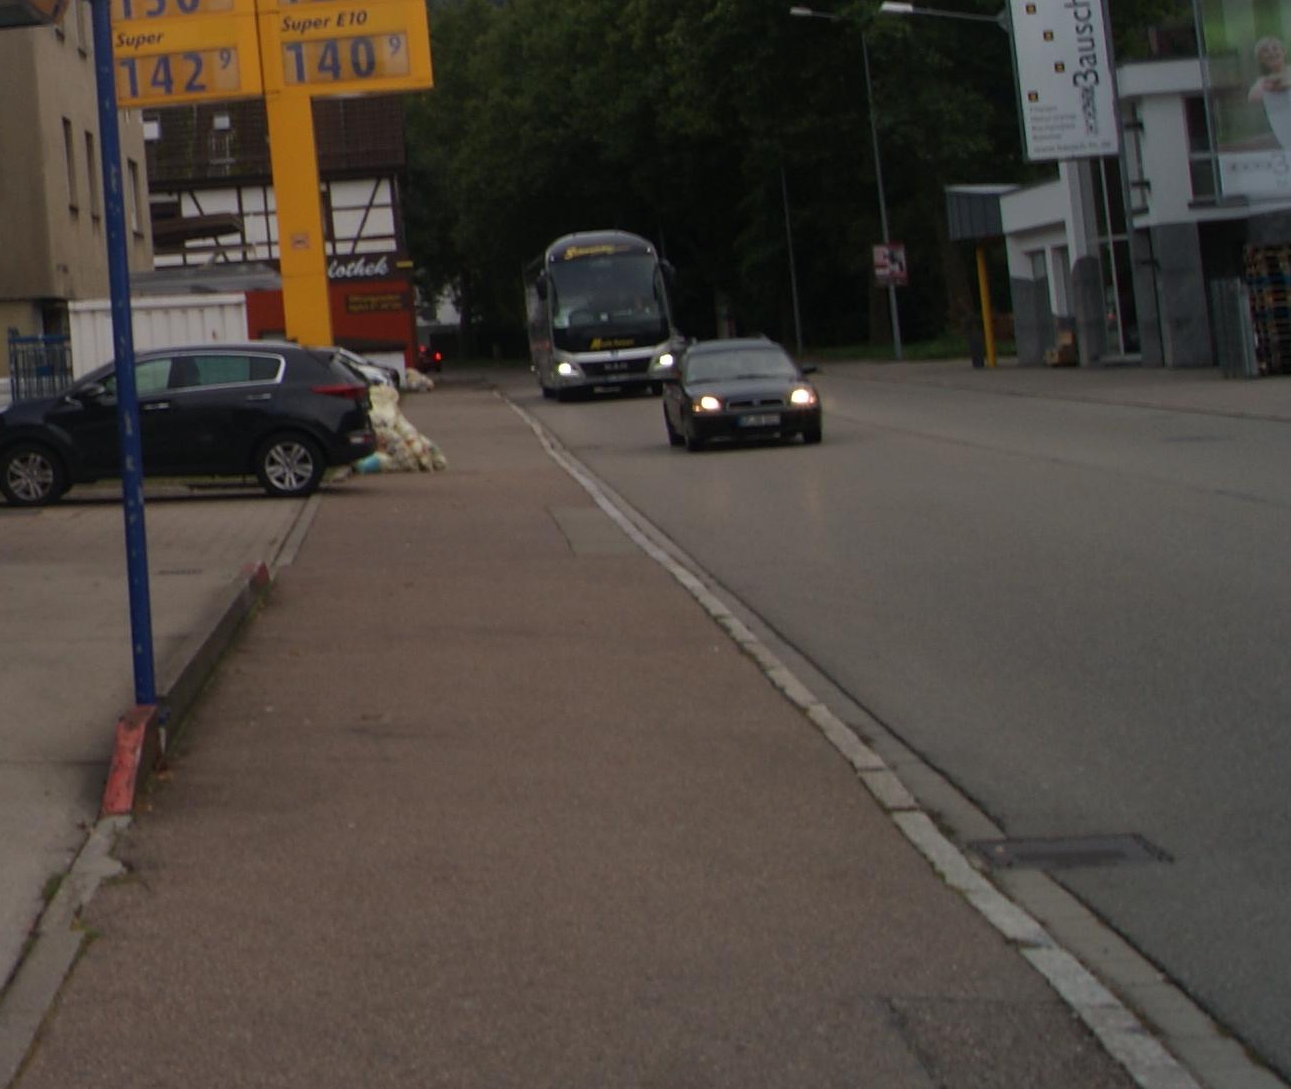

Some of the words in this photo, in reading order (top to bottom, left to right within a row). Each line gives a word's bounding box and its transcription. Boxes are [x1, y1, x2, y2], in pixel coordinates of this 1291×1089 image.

[281, 15, 331, 35] Super
[336, 10, 368, 29] E10
[116, 32, 165, 51] Super
